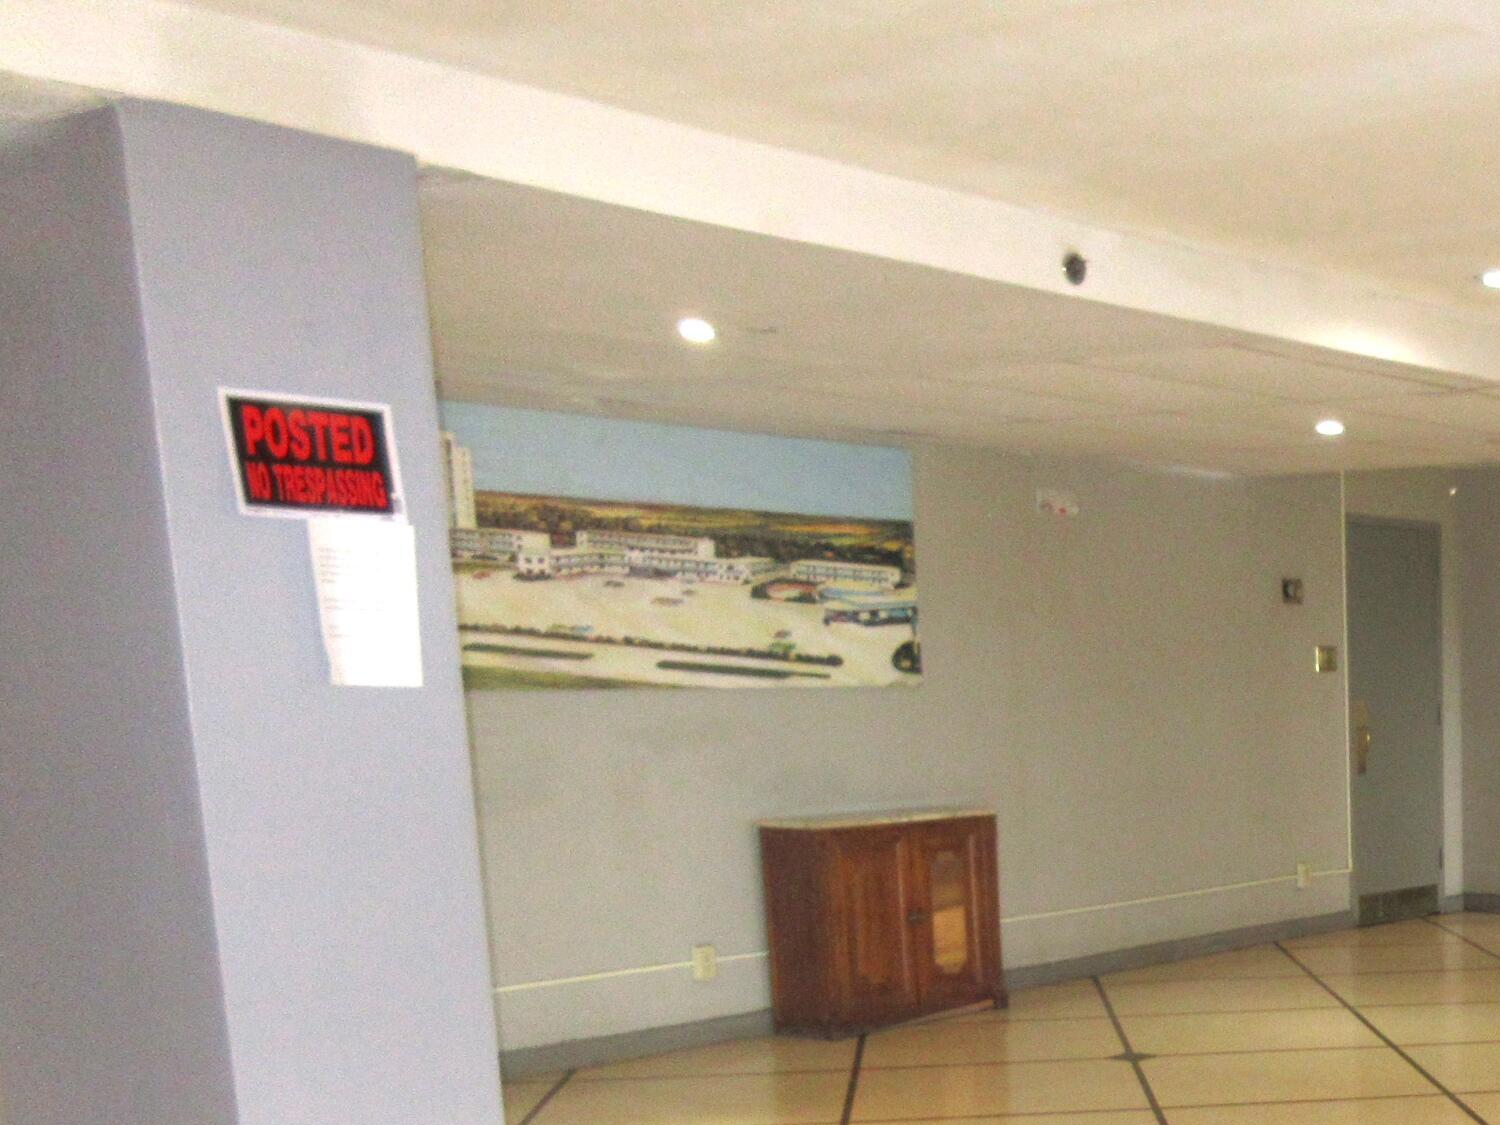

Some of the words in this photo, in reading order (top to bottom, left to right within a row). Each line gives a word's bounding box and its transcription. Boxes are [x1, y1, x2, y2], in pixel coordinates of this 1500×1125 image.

[241, 404, 374, 464] POSTED
[246, 461, 272, 499] NO
[273, 464, 388, 508] TRESPASSING
